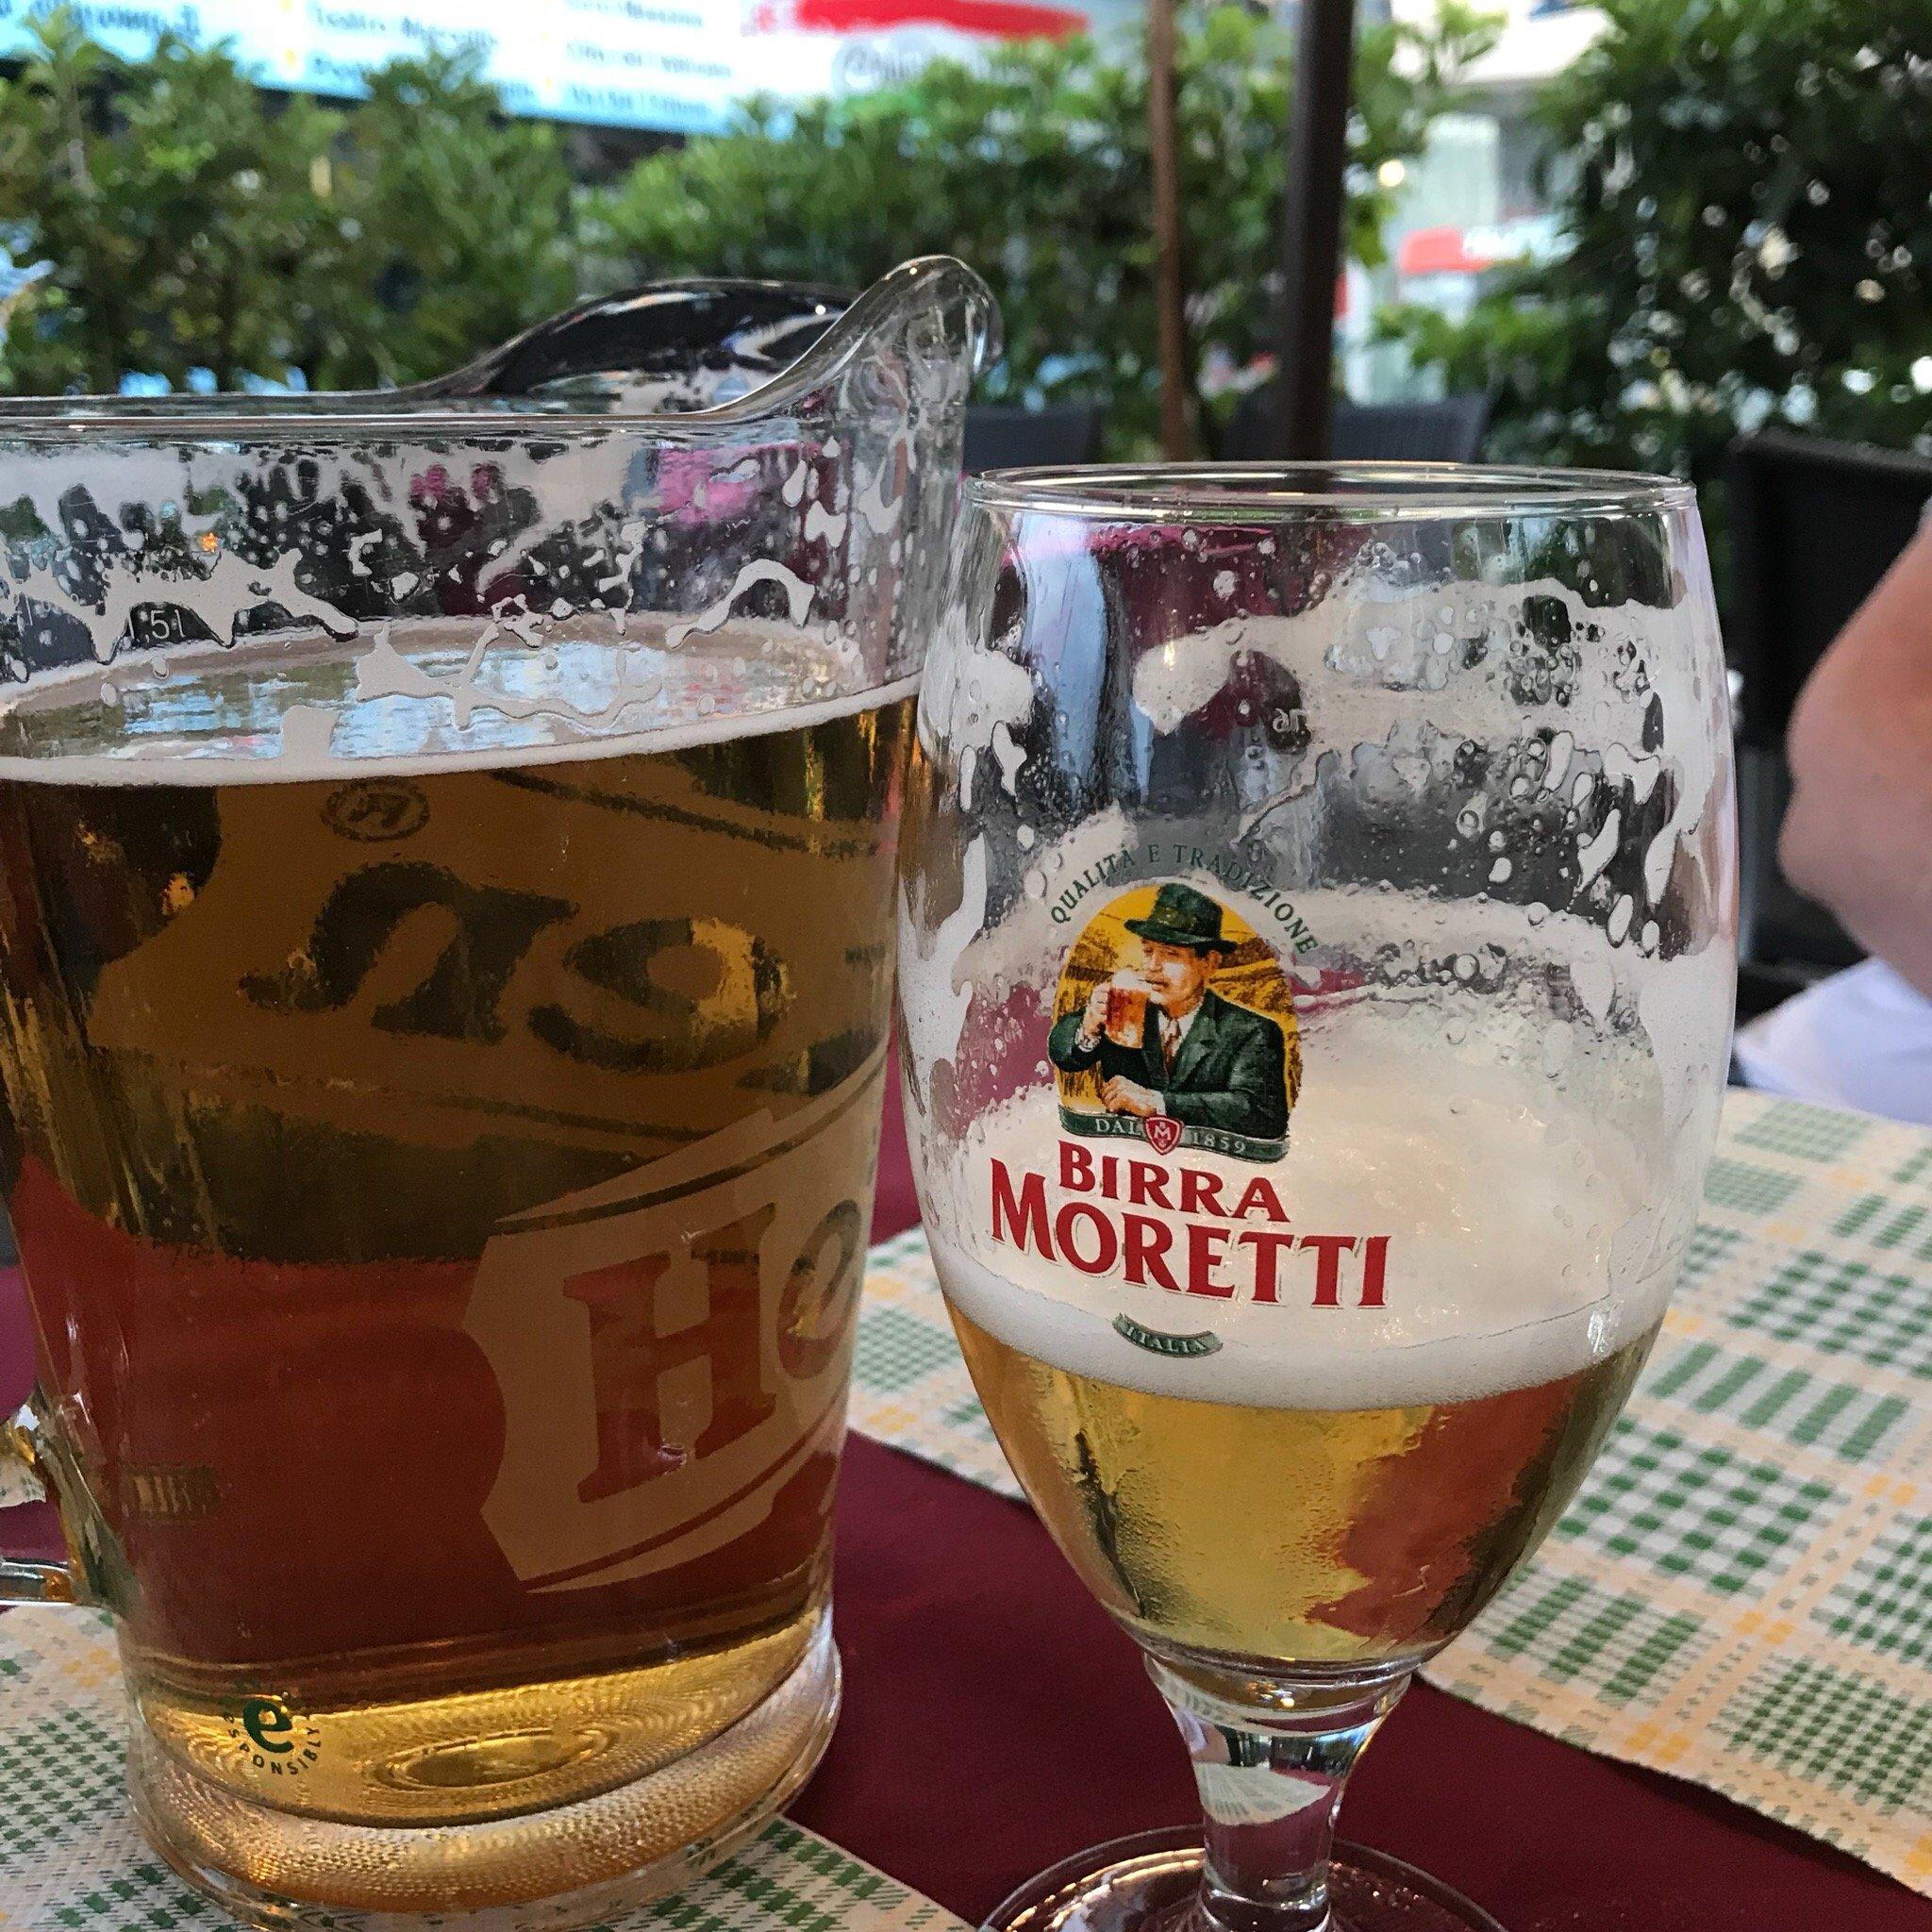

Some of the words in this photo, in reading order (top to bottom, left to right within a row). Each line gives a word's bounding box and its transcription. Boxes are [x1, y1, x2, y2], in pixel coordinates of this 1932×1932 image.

[1147, 843, 1160, 863] E
[1173, 843, 1319, 955] TRADIZIONE
[1095, 1118, 1141, 1136] DAL
[1190, 1129, 1247, 1154] 1859
[1058, 1140, 1291, 1223] BIRRA
[991, 1158, 1392, 1309] MORETTI
[1126, 1325, 1208, 1355] ITALIA
